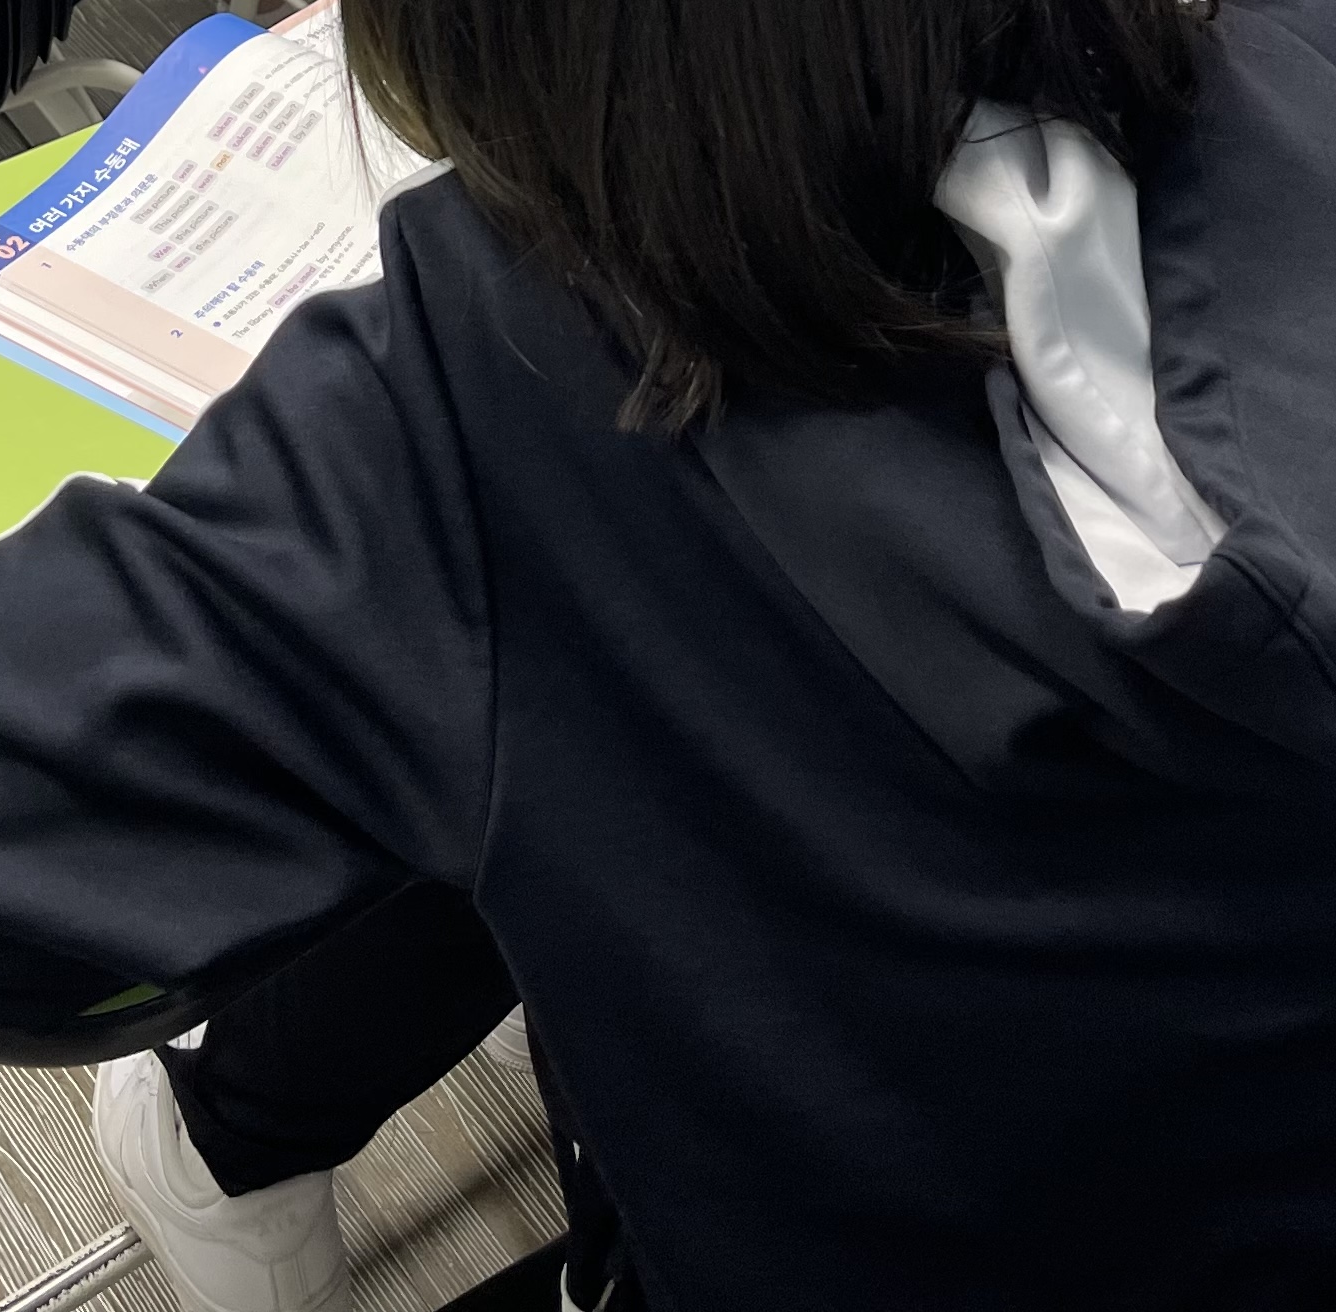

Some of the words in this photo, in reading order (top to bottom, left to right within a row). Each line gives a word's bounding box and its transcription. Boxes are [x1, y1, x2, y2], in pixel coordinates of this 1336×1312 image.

[28, 207, 67, 233] 여러
[60, 181, 98, 209] 가지
[94, 138, 141, 182] 수동태
[232, 326, 249, 339] The
